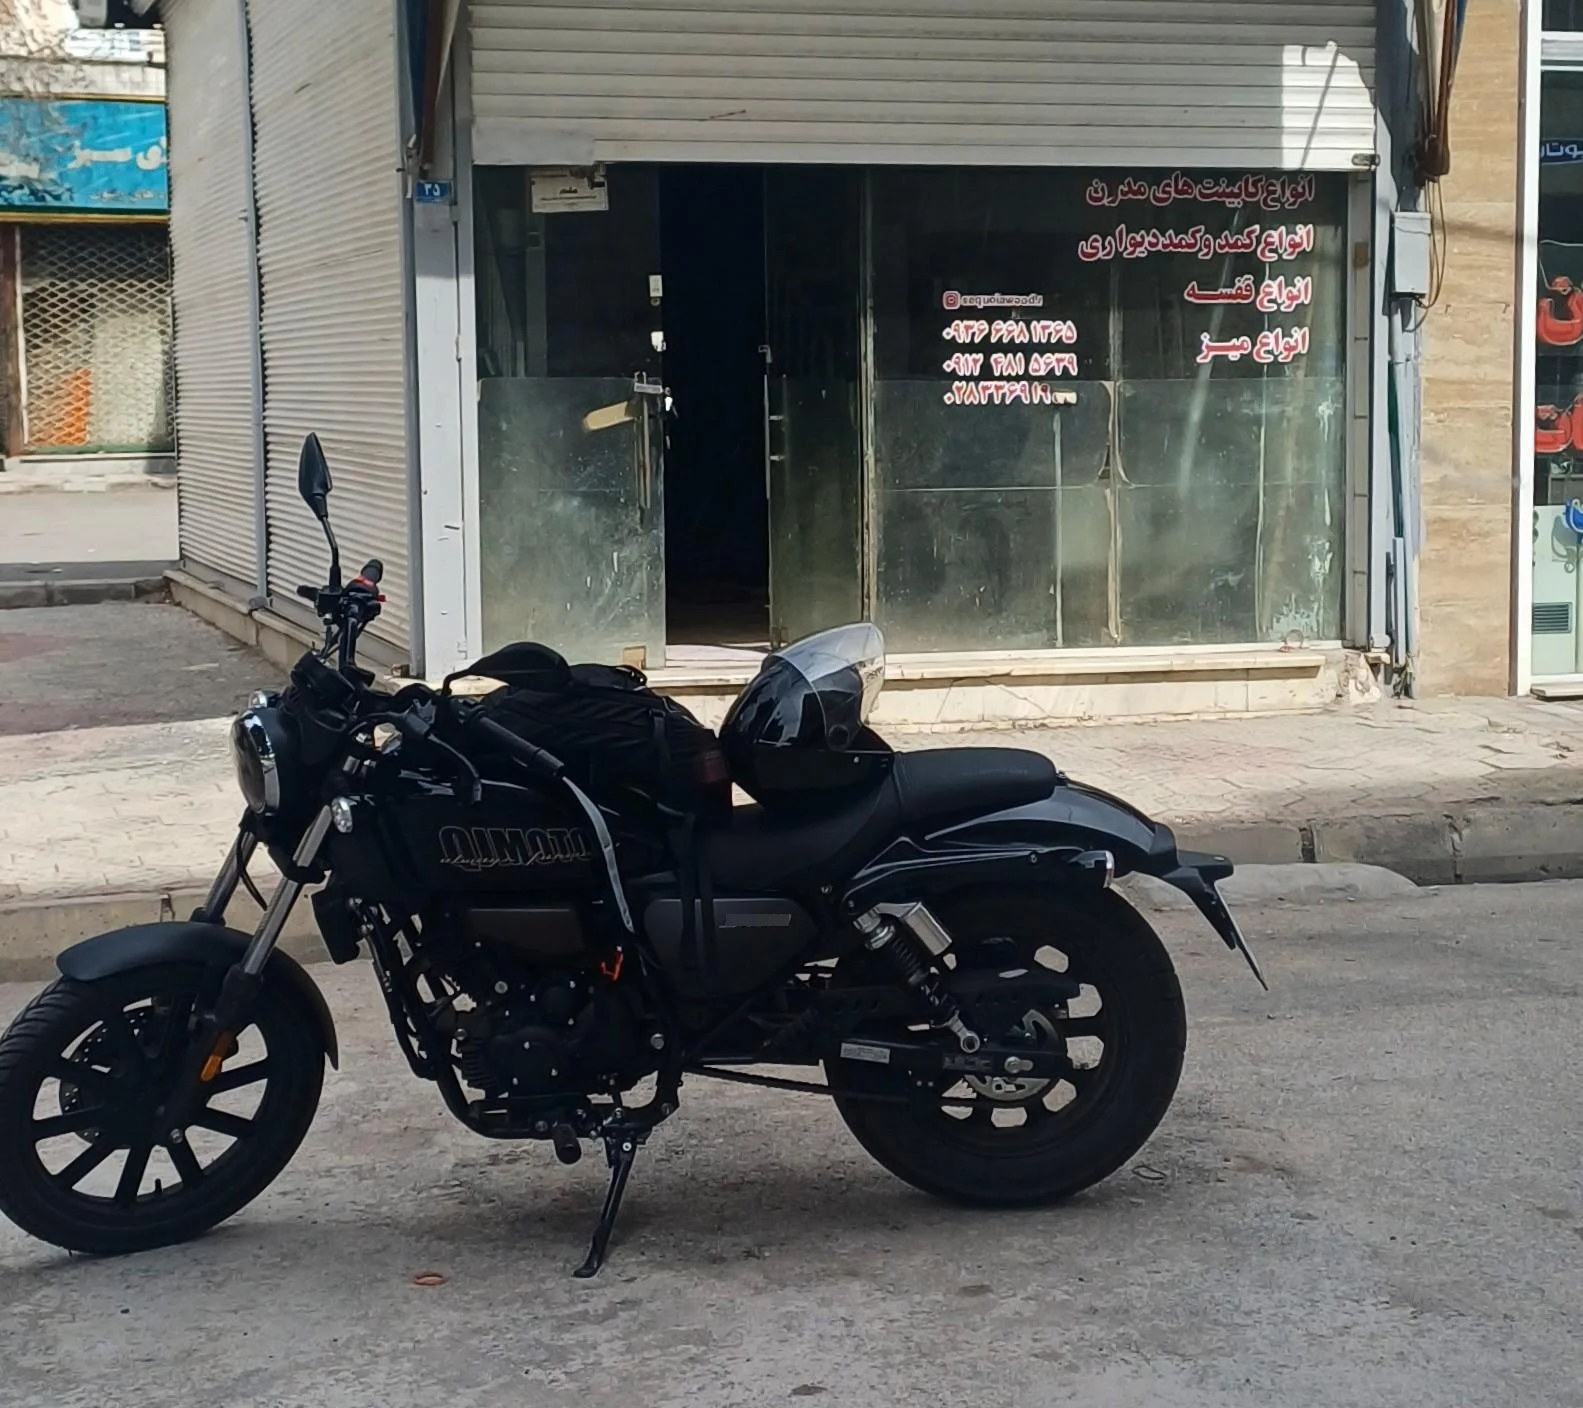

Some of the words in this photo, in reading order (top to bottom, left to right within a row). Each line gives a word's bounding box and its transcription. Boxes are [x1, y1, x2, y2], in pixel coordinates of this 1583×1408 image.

[1087, 178, 1149, 206] مدرن
[1150, 171, 1195, 206] های
[1196, 175, 1264, 208] کابینت
[1259, 174, 1315, 209] انواع
[1216, 225, 1260, 253] کمد
[1257, 224, 1314, 261] انواع
[1184, 275, 1255, 303] قفسه
[1256, 276, 1312, 312] انواع
[1197, 332, 1252, 363] میز
[1253, 327, 1310, 362] انواع
[942, 353, 984, 376] ۰۹۱۲
